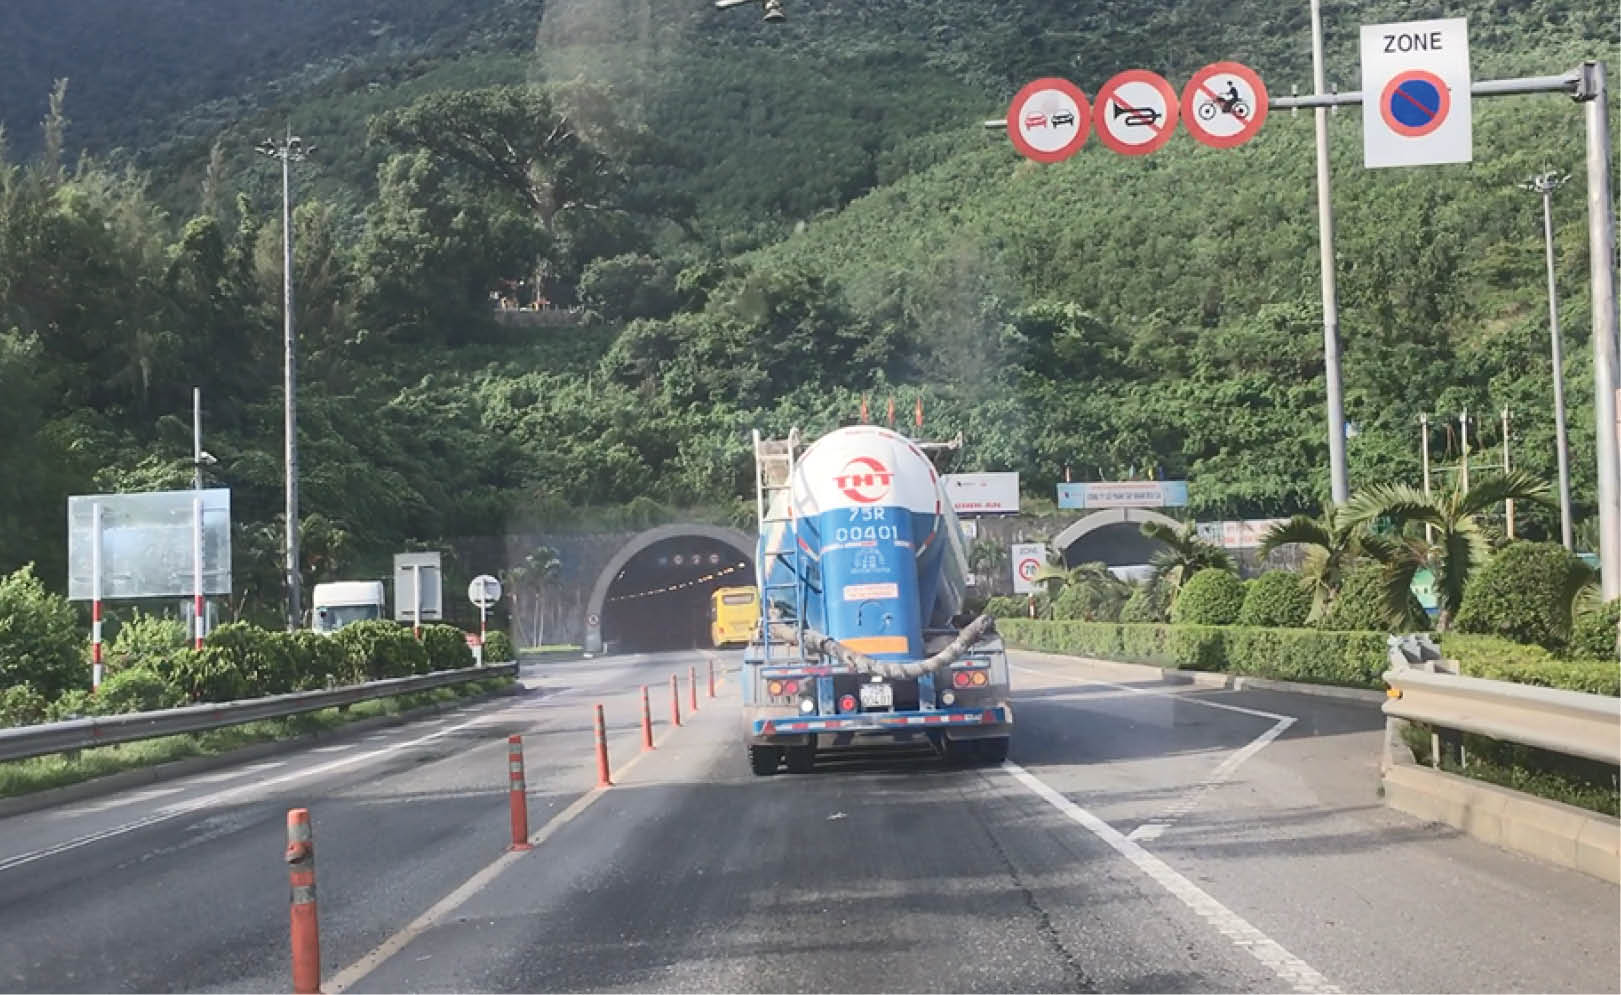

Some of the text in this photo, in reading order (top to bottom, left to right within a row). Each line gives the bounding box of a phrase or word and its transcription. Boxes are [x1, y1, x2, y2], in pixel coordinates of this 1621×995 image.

[1383, 31, 1443, 53] ZONE
[832, 471, 896, 489] THT
[849, 506, 886, 521] 75R
[836, 525, 898, 541] 00401
